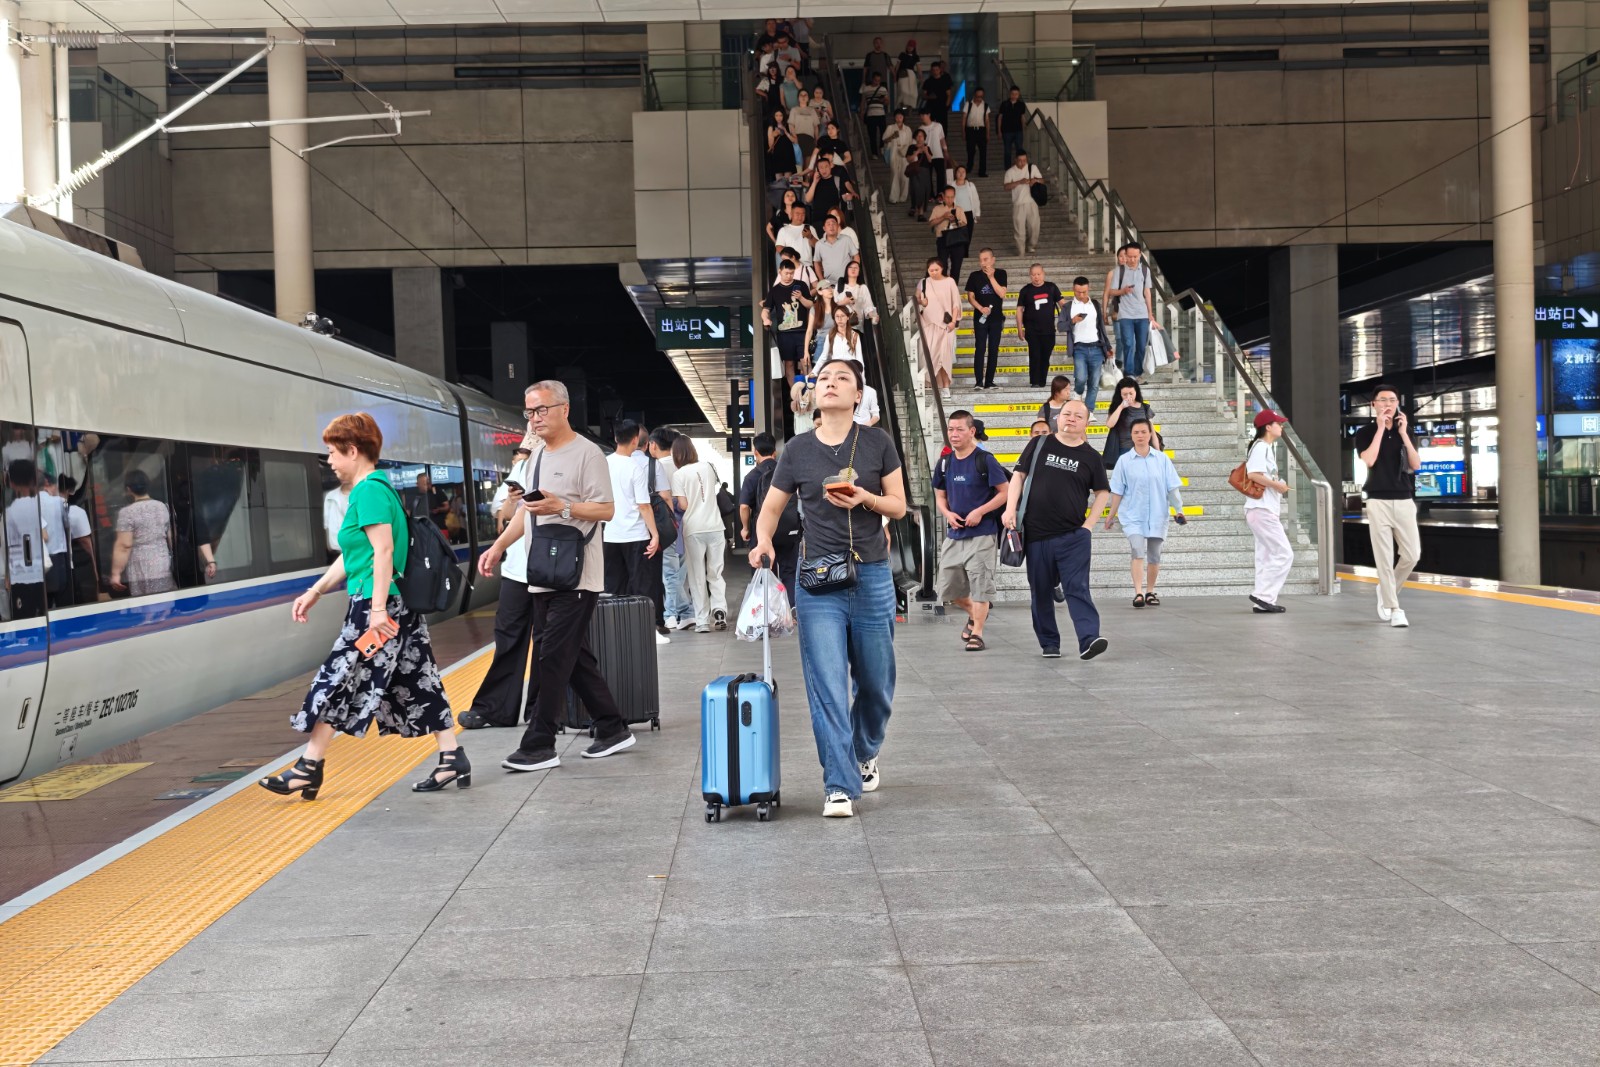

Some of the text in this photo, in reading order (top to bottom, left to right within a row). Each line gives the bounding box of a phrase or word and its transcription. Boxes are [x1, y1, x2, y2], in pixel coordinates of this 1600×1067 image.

[1534, 307, 1575, 320] 出站口
[661, 318, 702, 332] 出站口
[748, 456, 754, 465] 8
[1046, 453, 1080, 468] BIEM
[98, 689, 140, 719] ZEC 102705
